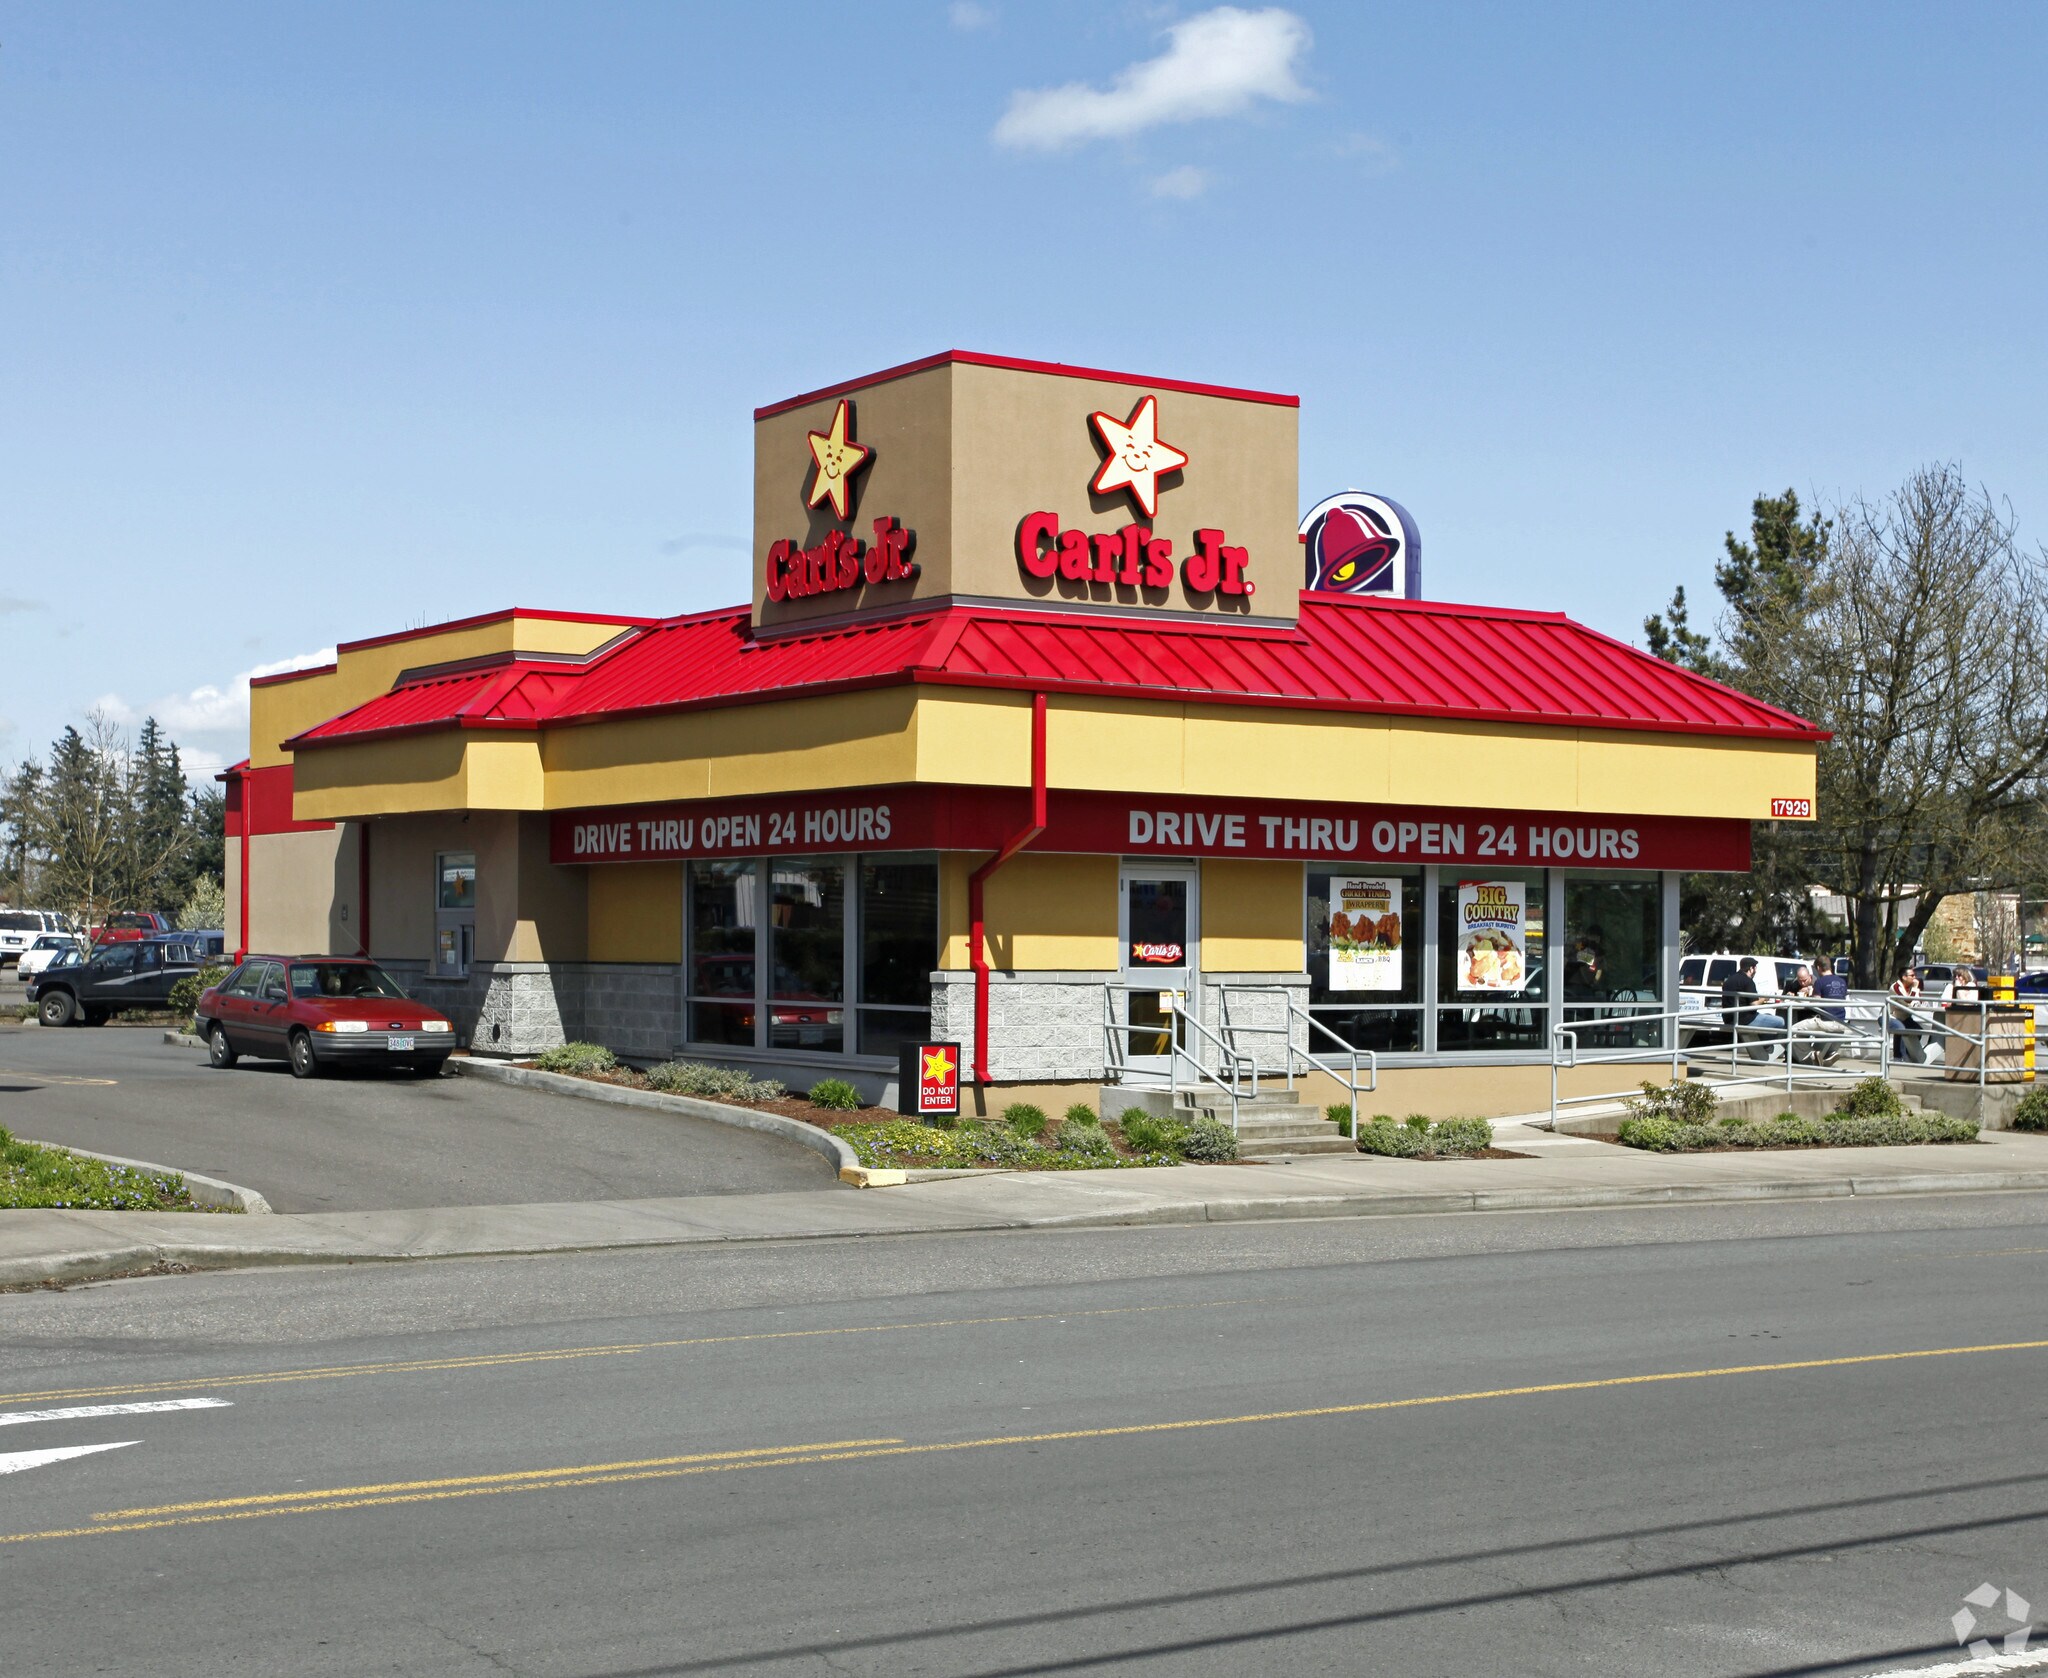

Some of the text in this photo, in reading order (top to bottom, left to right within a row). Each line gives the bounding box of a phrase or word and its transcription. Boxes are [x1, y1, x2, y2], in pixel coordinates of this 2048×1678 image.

[767, 516, 912, 602] Carl's Jr.
[1020, 511, 1255, 595] Carl's Jr.
[1773, 800, 1809, 816] 17929
[574, 806, 891, 854] DRIVE THRU OPEN 24 HOURS
[1129, 810, 1639, 859] DRIVE THRU OPEN 24 HOURS
[1477, 886, 1506, 905] BIG
[1350, 901, 1384, 909] WRAPPERS
[1465, 904, 1518, 921] COUNTRY
[1468, 922, 1516, 930] BREAKFAST BURRITO
[923, 1086, 954, 1095] DO NOT
[925, 1096, 951, 1104] ENTER
